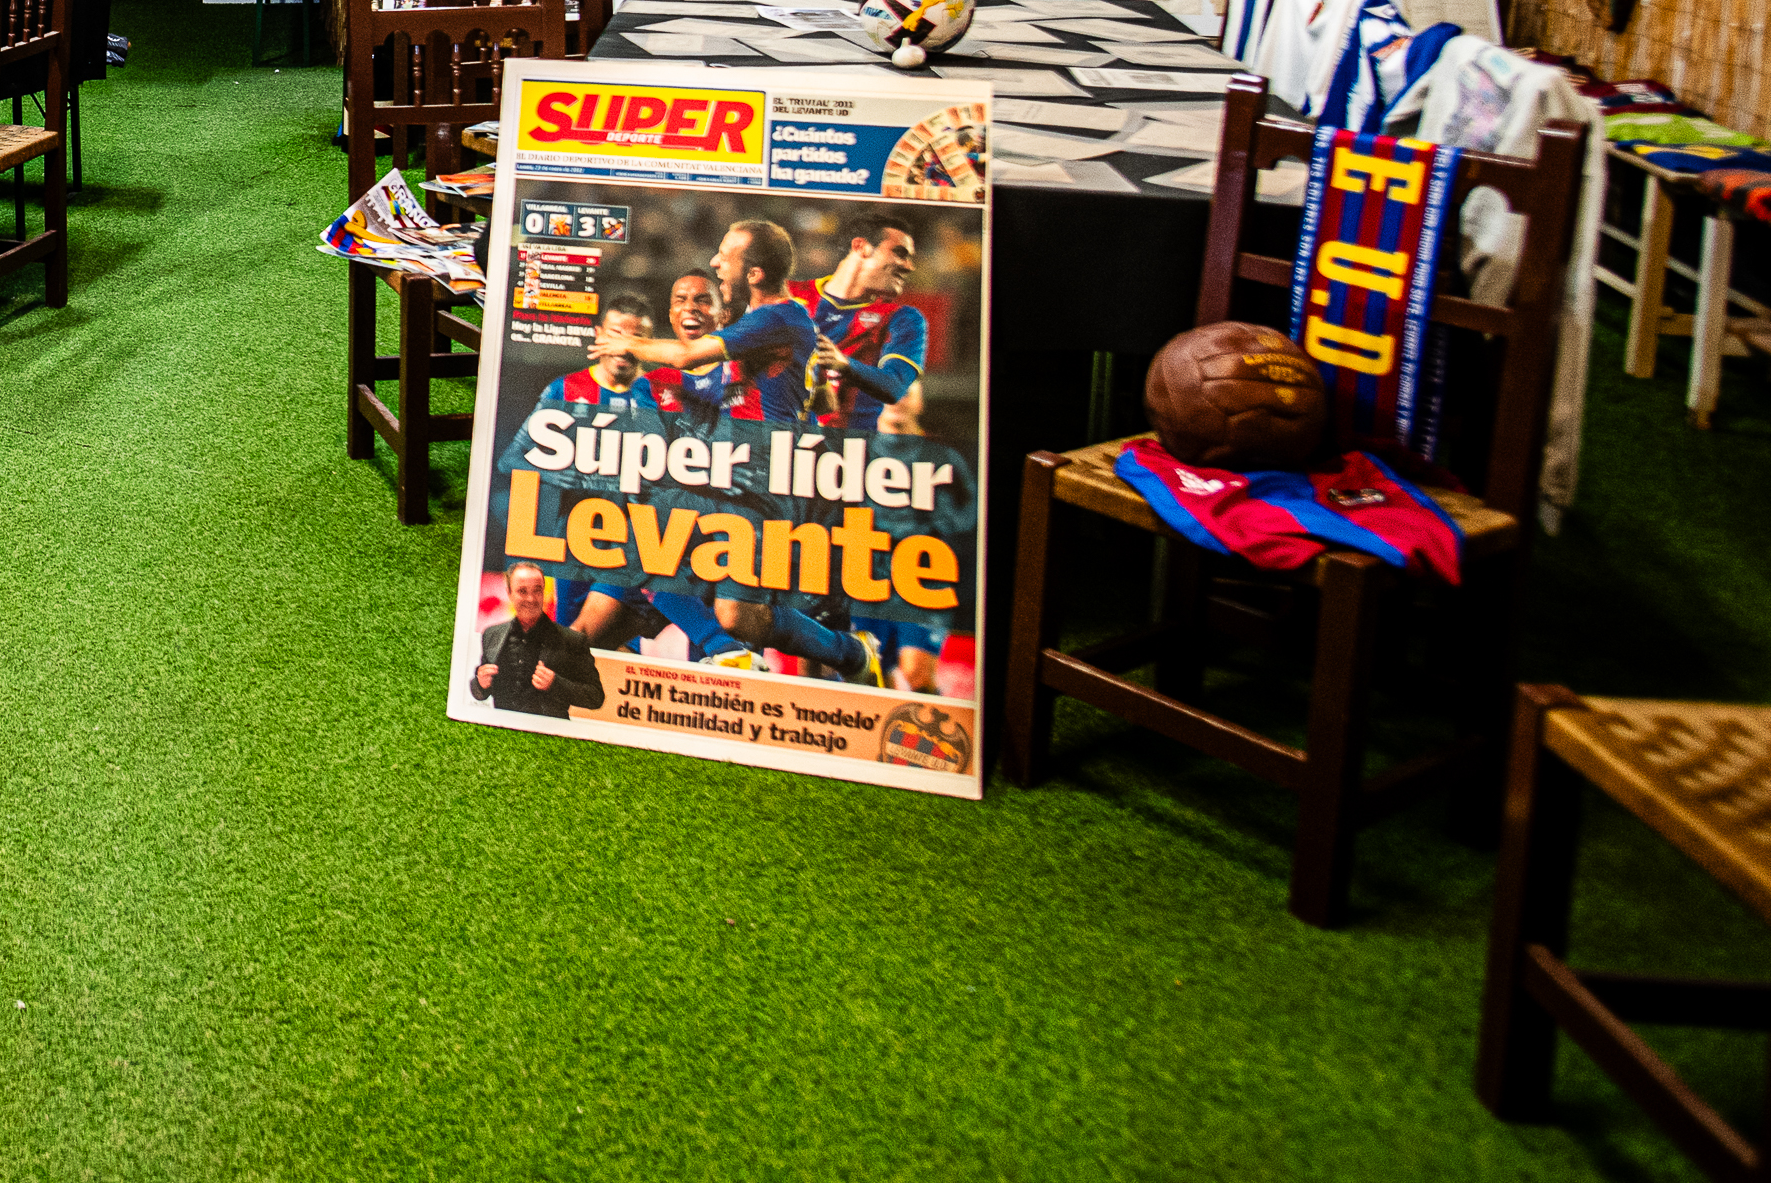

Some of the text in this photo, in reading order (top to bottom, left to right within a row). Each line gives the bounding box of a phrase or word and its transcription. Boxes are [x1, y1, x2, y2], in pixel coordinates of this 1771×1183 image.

[773, 106, 849, 116] DEL LEVANTE UD
[833, 100, 854, 109] 2011
[529, 91, 755, 154] SUPER
[606, 131, 663, 146] DEPORTE
[772, 125, 856, 145] ¿Cuántos
[516, 152, 763, 174] EL DIARIO DEPORTIVO DE LA COMUNITAT VALENCIANA
[771, 146, 847, 164] partidos
[771, 164, 792, 180] ha
[794, 167, 870, 185] ganado?
[578, 206, 610, 215] LEVANTE
[525, 212, 544, 234] 0
[578, 216, 596, 237] 3
[511, 321, 531, 333] Hoy
[532, 322, 543, 332] la
[544, 323, 566, 335] Liga
[532, 333, 582, 347] GRANOTA
[524, 409, 953, 511] Súper líder
[504, 469, 959, 609] Levante
[639, 667, 678, 681] TÉCNICO
[679, 672, 697, 683] DEL
[699, 676, 742, 689] LEVANTE
[618, 679, 881, 731] JIM también es 'modelo'
[617, 700, 848, 753] de humildad y trabajo
